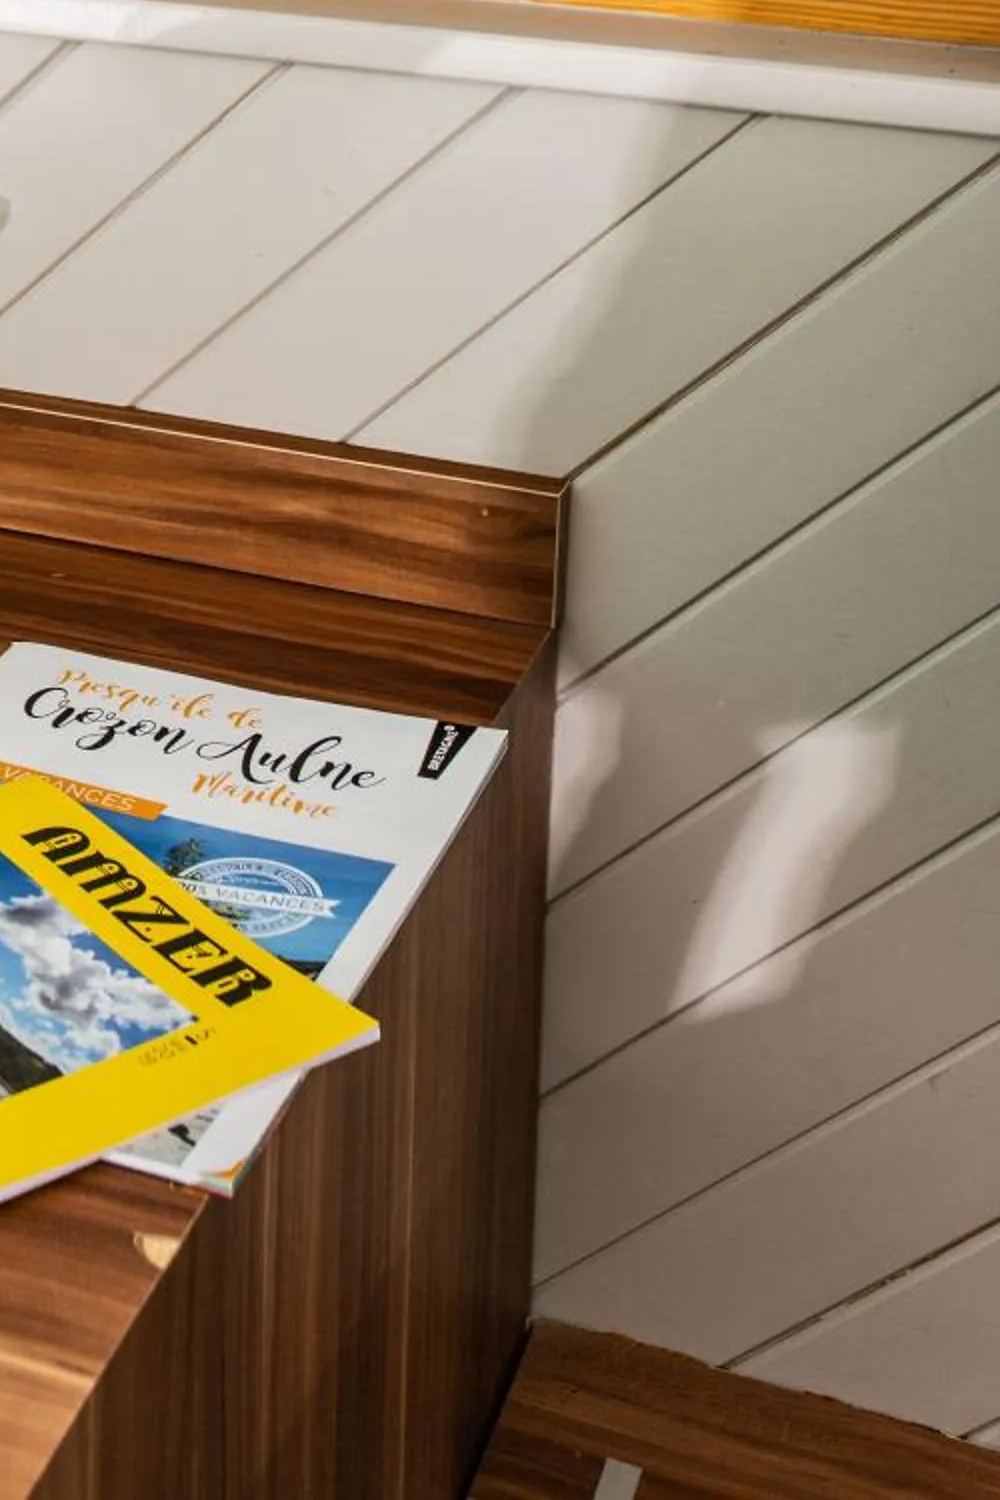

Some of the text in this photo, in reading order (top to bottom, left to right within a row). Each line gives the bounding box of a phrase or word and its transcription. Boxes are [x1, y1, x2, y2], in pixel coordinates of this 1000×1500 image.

[23, 686, 386, 791] Crozon Aulne
[4, 768, 137, 812] VANCES
[20, 826, 273, 1007] AMZER
[216, 888, 328, 913] VACANCES
